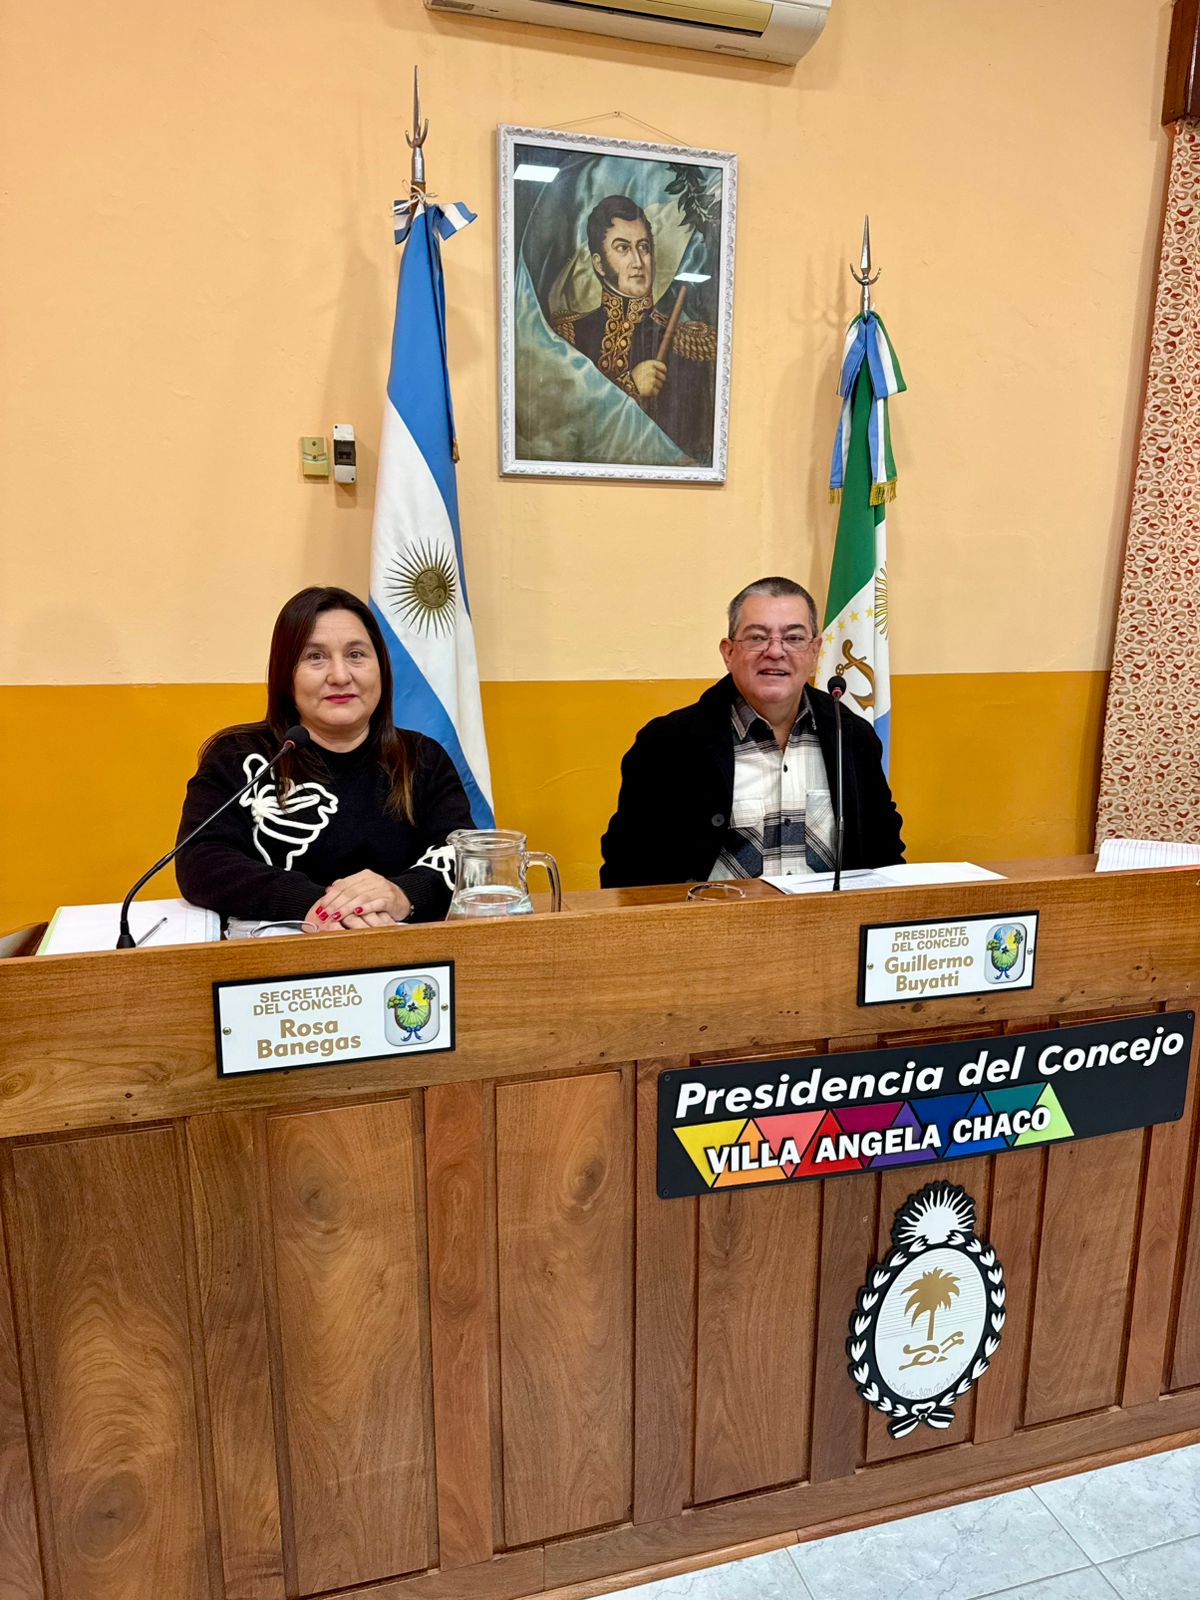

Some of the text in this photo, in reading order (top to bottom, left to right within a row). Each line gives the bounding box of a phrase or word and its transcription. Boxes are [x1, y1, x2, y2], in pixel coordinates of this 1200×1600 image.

[894, 926, 967, 941] PRESIDENTE
[891, 936, 970, 953] DEL CONCEJO
[884, 954, 974, 974] Guillermo
[896, 971, 959, 994] Buyatti
[260, 984, 358, 1003] SECRETARIA
[253, 994, 363, 1016] DEL CONCEJO
[280, 1018, 339, 1039] Rosa
[257, 1034, 362, 1059] Banegas
[675, 1026, 1185, 1119] Presidencia del Concejo
[706, 1106, 1052, 1175] VILLA ANGELA CHACO
